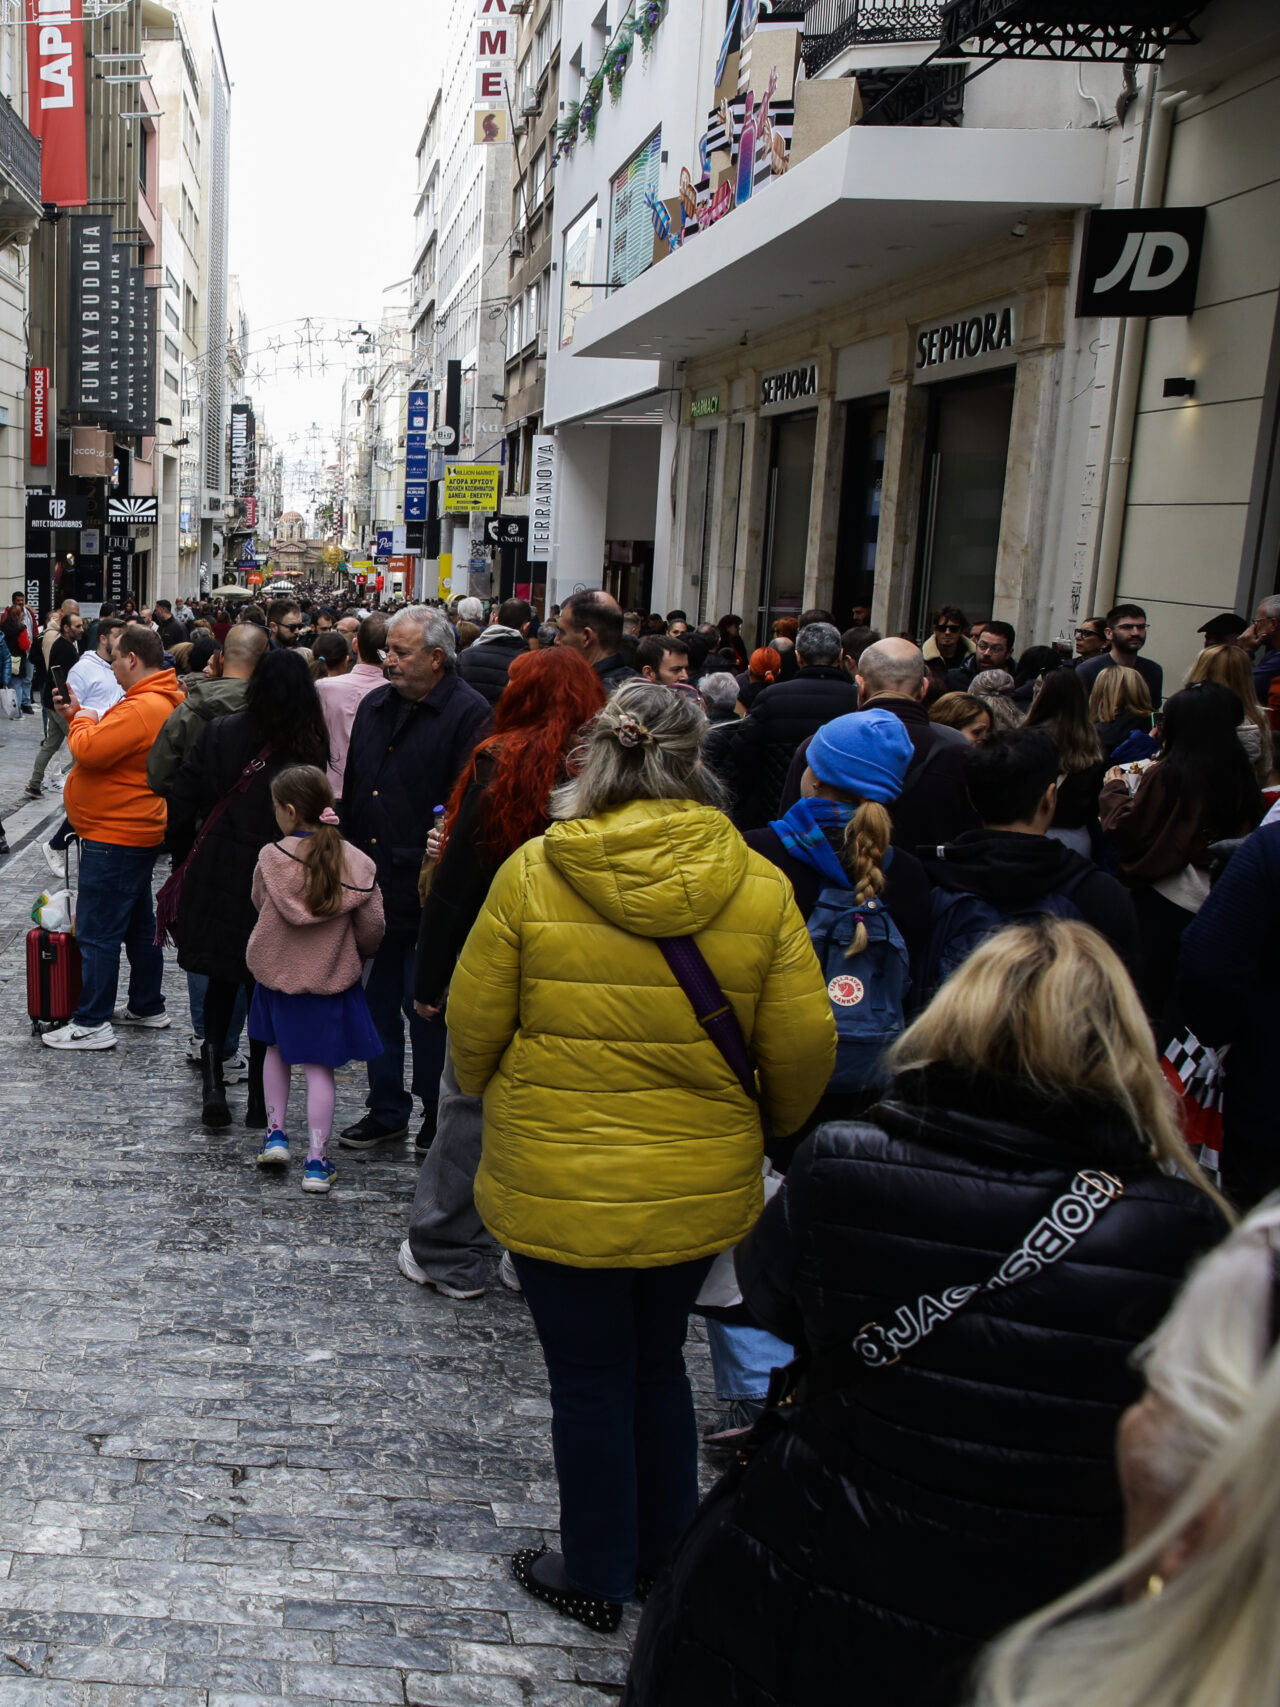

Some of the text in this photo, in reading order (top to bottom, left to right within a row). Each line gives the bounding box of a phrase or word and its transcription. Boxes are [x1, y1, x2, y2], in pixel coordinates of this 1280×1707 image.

[1092, 231, 1190, 294] JD
[81, 225, 101, 403] FUNKYBUDDHA
[916, 308, 1014, 369] SEPHORA
[34, 370, 44, 437] LAPIN HOUSE
[691, 396, 719, 417] PHARMACY
[761, 365, 817, 405] SEPHORA
[437, 431, 452, 439] Big
[532, 443, 554, 555] TERRANOVA
